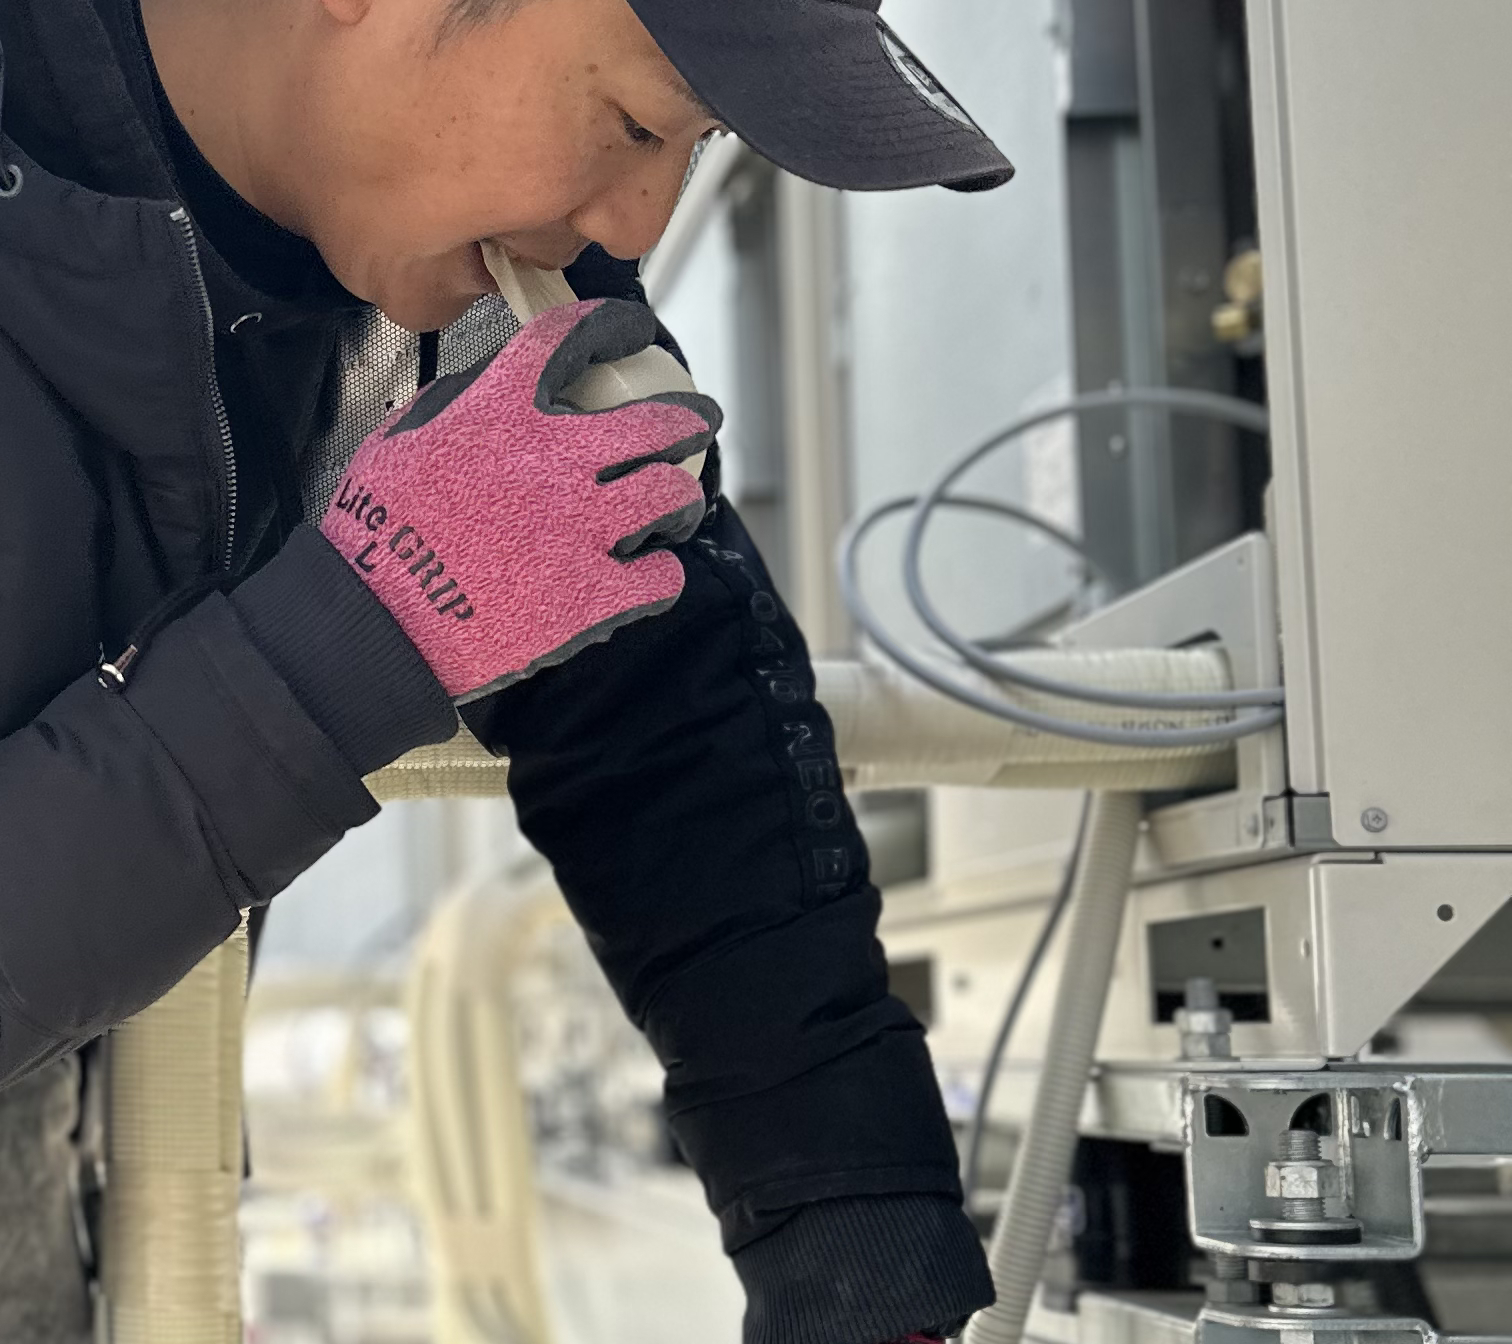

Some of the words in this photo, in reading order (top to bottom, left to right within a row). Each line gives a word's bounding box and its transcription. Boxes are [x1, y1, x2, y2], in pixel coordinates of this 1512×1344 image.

[337, 477, 387, 531] Lite
[389, 525, 474, 620] GRIP
[355, 541, 377, 573] L
[782, 721, 843, 830] NEO
